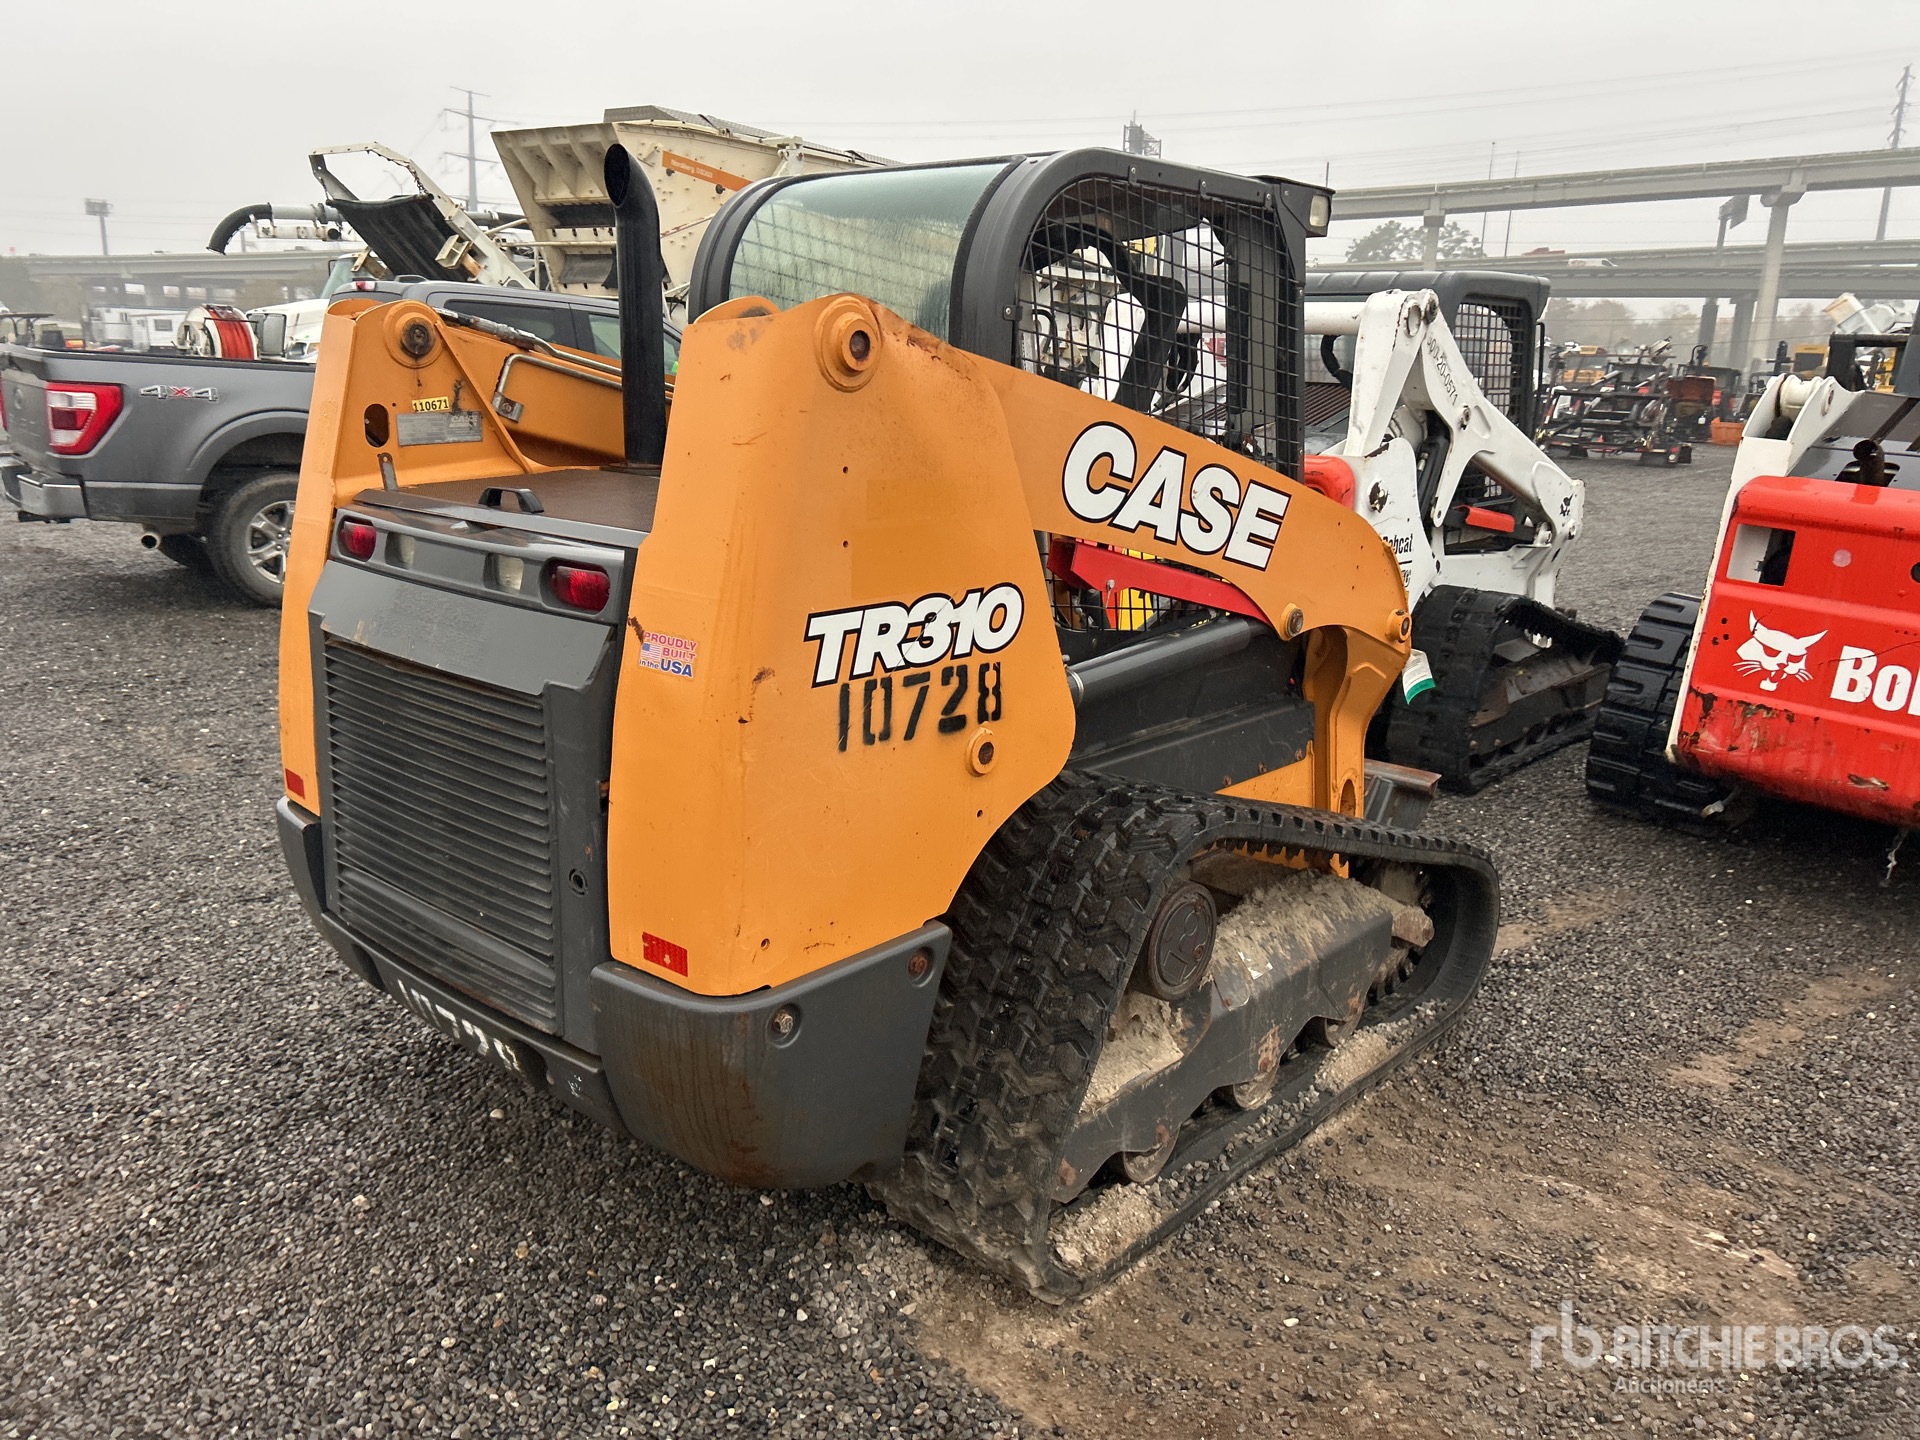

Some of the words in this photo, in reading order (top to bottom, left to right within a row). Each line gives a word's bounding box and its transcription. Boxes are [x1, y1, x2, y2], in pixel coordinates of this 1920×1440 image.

[413, 399, 449, 412] 110671
[1062, 420, 1293, 573] CASE
[644, 631, 697, 651] PROUDLY
[803, 581, 1025, 689] TR310
[662, 647, 696, 660] BUILT
[647, 660, 660, 670] the
[660, 658, 692, 677] USA
[838, 661, 1002, 753] 10728
